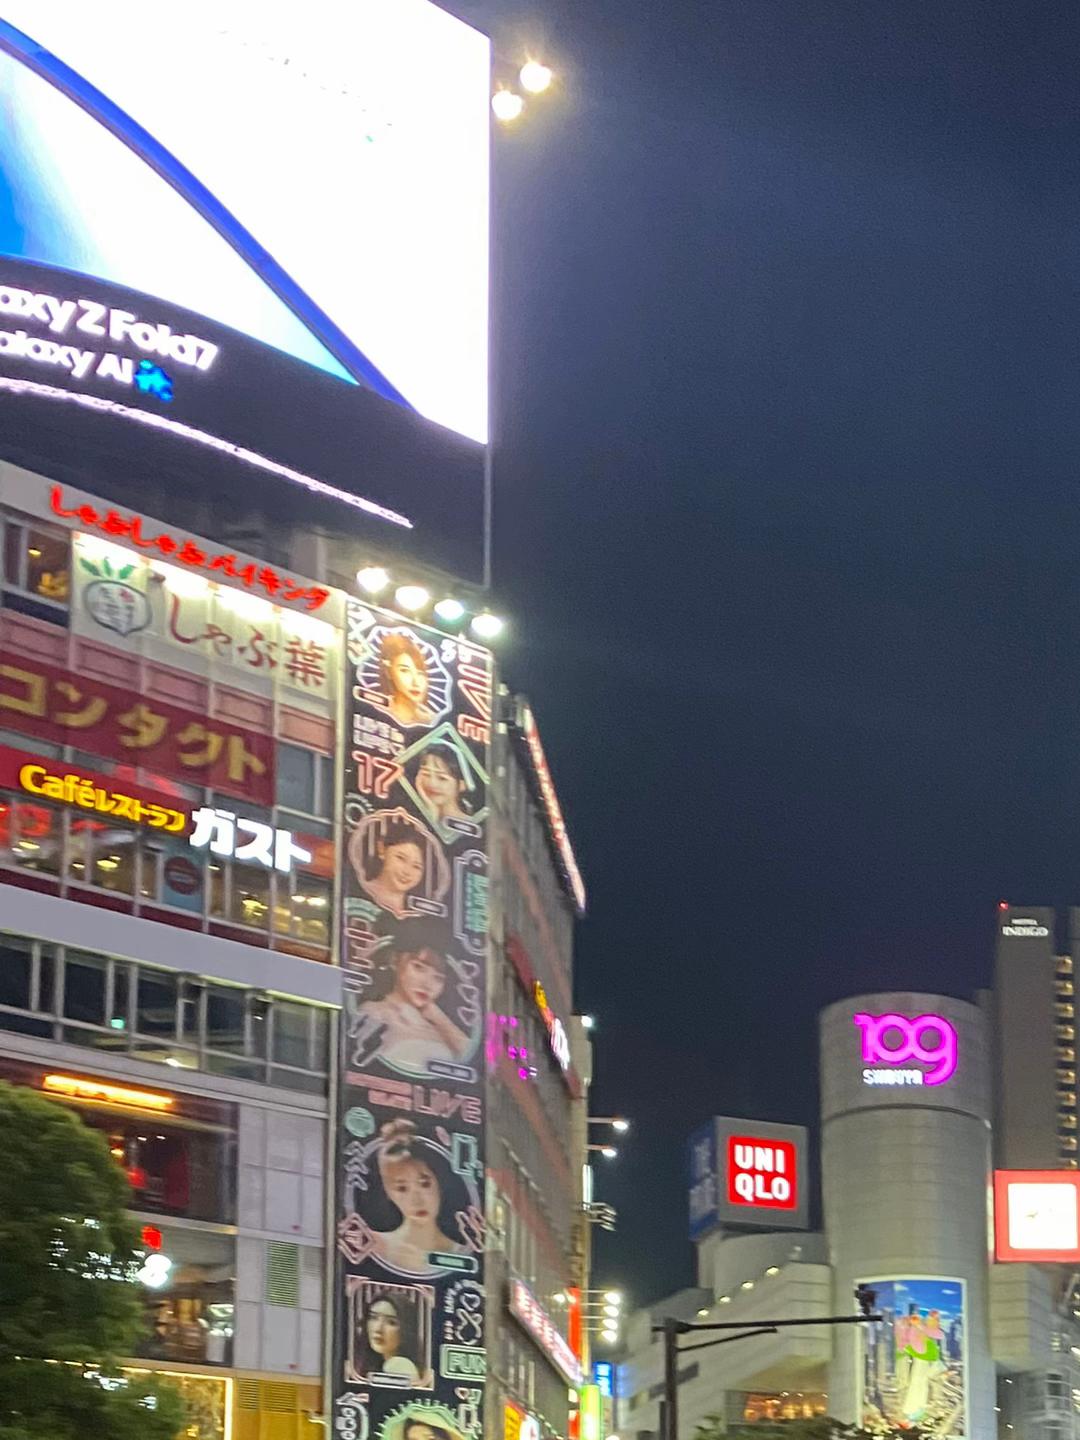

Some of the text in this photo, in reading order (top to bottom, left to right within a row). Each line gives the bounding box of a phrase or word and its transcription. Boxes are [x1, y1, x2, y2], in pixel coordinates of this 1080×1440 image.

[77, 299, 107, 335] Z
[109, 308, 218, 371] Fold7
[96, 353, 133, 384] AI
[51, 485, 330, 610] しゃぶしゃぶバイキング
[170, 592, 326, 687] しゃぶ葉
[0, 664, 267, 782] コンタクト
[190, 807, 312, 873] ガスト
[1002, 926, 1049, 937] INDIGO
[854, 1013, 958, 1086] 109
[734, 1144, 786, 1174] UNI
[735, 1173, 791, 1202] QLO
